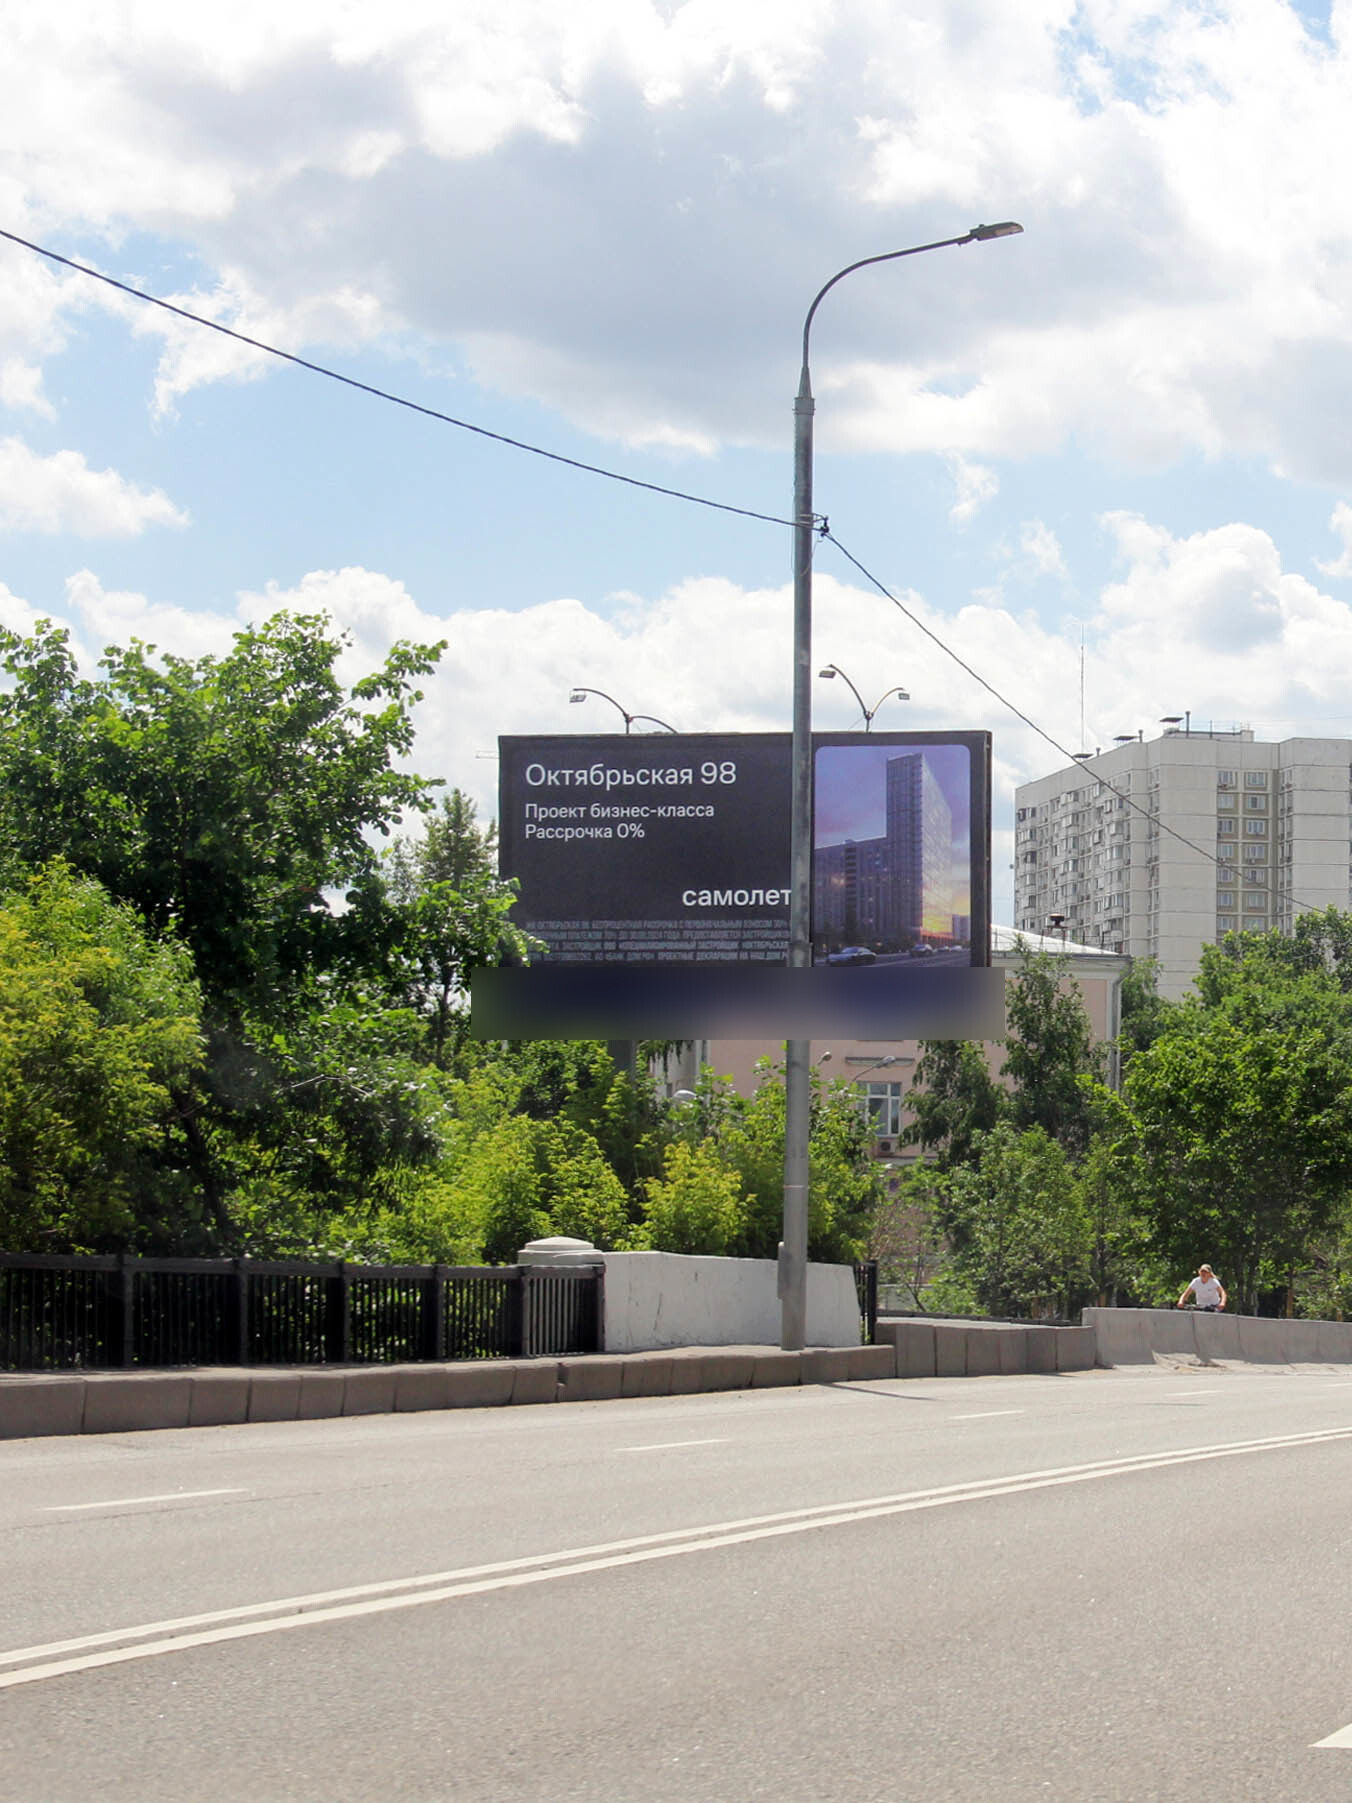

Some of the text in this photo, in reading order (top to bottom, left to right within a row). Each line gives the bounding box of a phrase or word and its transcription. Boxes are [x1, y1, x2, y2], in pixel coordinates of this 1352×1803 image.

[525, 761, 736, 791] Октябрьская 98
[525, 802, 715, 822] Проект бизнес-класса
[525, 823, 646, 842] Рассрочка 0%
[682, 889, 792, 907] самолет
